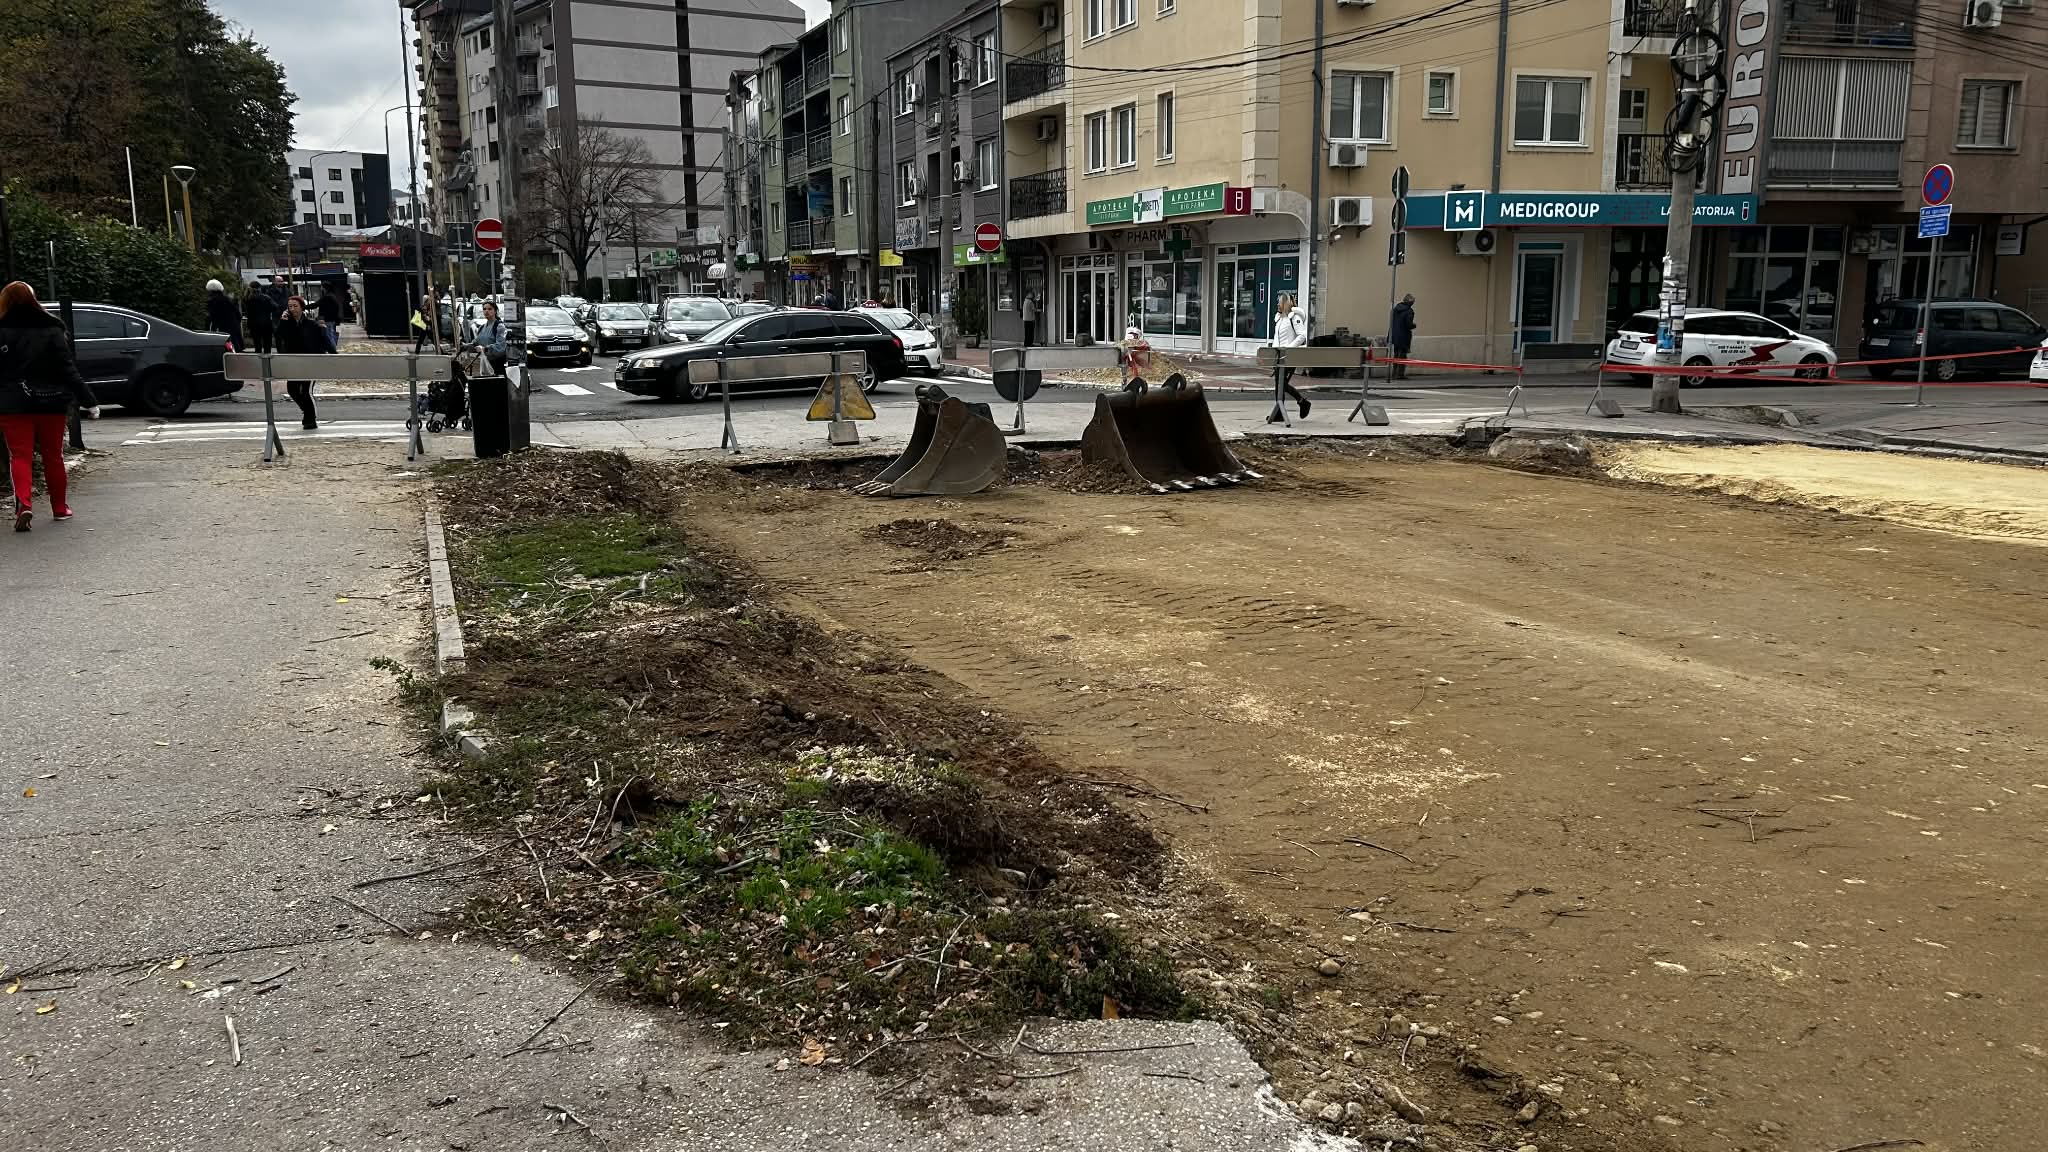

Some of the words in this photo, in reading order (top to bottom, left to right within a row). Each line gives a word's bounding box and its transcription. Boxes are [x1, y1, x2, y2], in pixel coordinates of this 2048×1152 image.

[1171, 188, 1215, 203] APOTEKA
[1092, 201, 1127, 212] APOTEKA
[1500, 202, 1600, 218] MEDIGROUP
[1660, 206, 1735, 216] LAATORIJA
[1127, 227, 1192, 243] PHARMY
